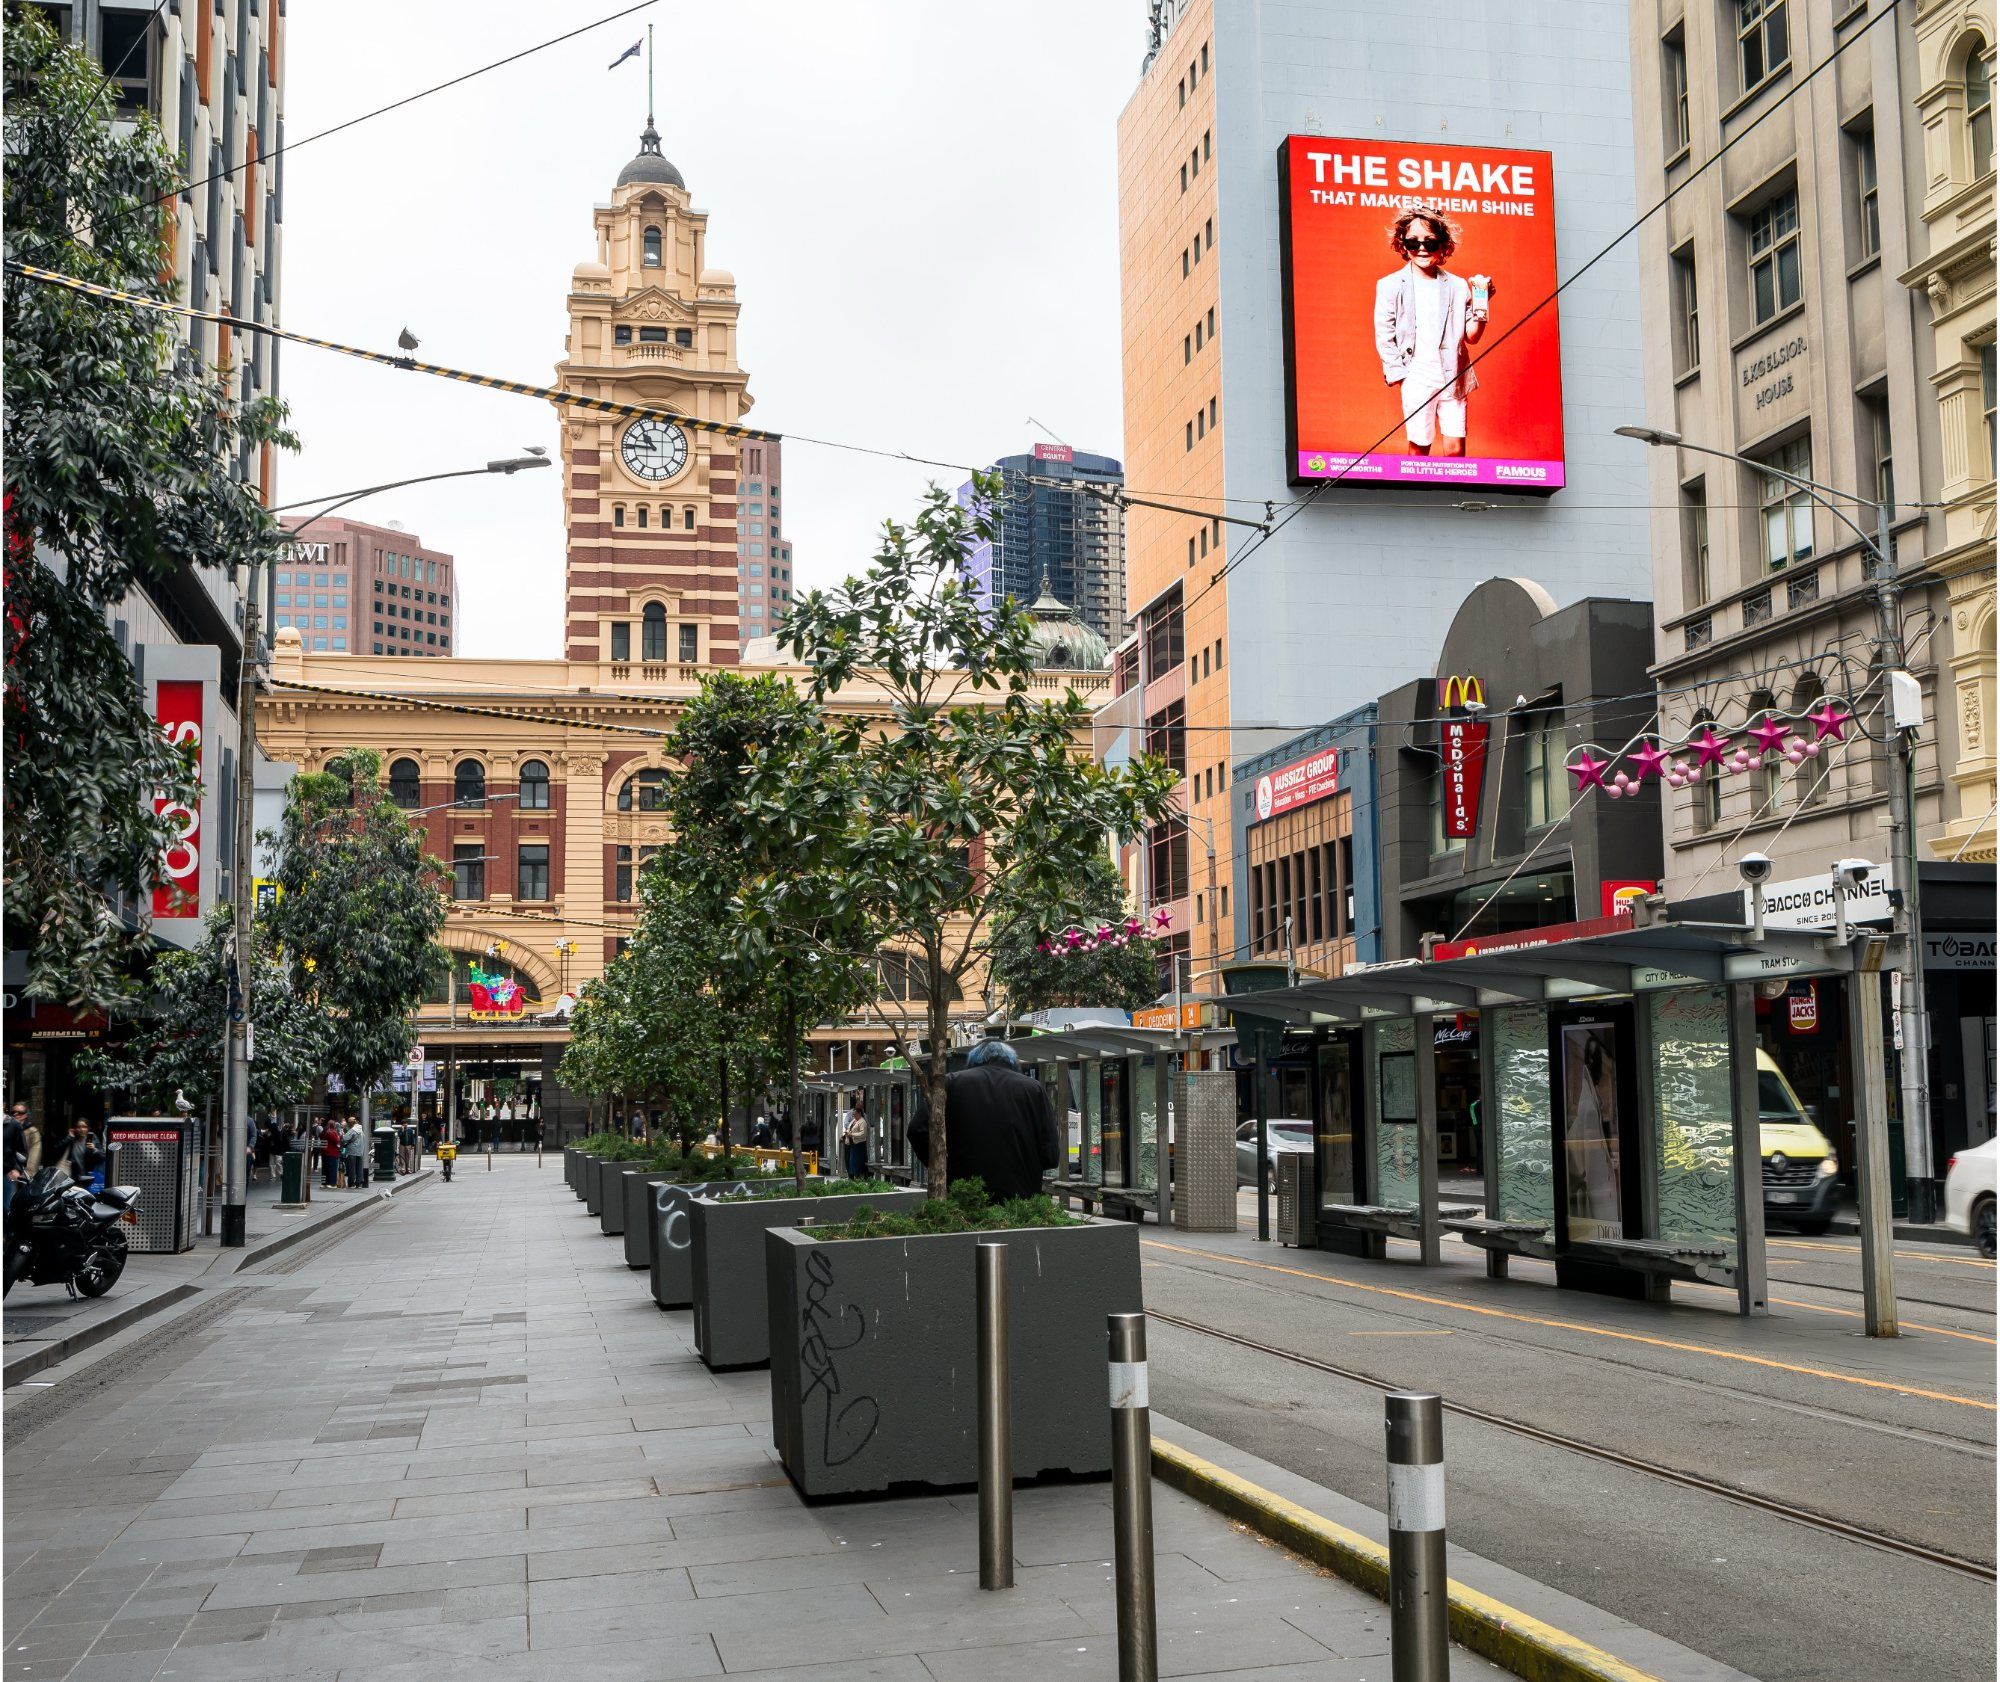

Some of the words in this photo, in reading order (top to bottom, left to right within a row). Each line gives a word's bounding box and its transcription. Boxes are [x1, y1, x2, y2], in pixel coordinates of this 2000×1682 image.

[1307, 152, 1388, 187] THE
[1398, 158, 1535, 196] SHAKE
[1310, 189, 1356, 206] THAT
[1360, 193, 1424, 209] MAKES
[1426, 197, 1478, 213] THEM
[1482, 200, 1535, 217] SHINE
[1743, 337, 1807, 387] EXCELSIOR
[1756, 374, 1793, 410] HOUSE
[1040, 444, 1067, 453] CENTRAL
[1042, 453, 1066, 461] EQUITY
[1400, 467, 1415, 475] BIG
[1416, 468, 1443, 476] LITTLE
[1495, 465, 1546, 478] FAMOUS
[1274, 765, 1306, 792] AUSSIZZ
[1306, 754, 1335, 779] GROUP
[1450, 725, 1469, 831] McDonald's
[1751, 892, 1811, 915] OBACCO
[1814, 879, 1889, 906] CHNNEL
[1797, 914, 1819, 926] SINCE
[1761, 958, 1781, 969] TRAM
[1646, 972, 1659, 983] CITY
[1660, 972, 1668, 981] OF
